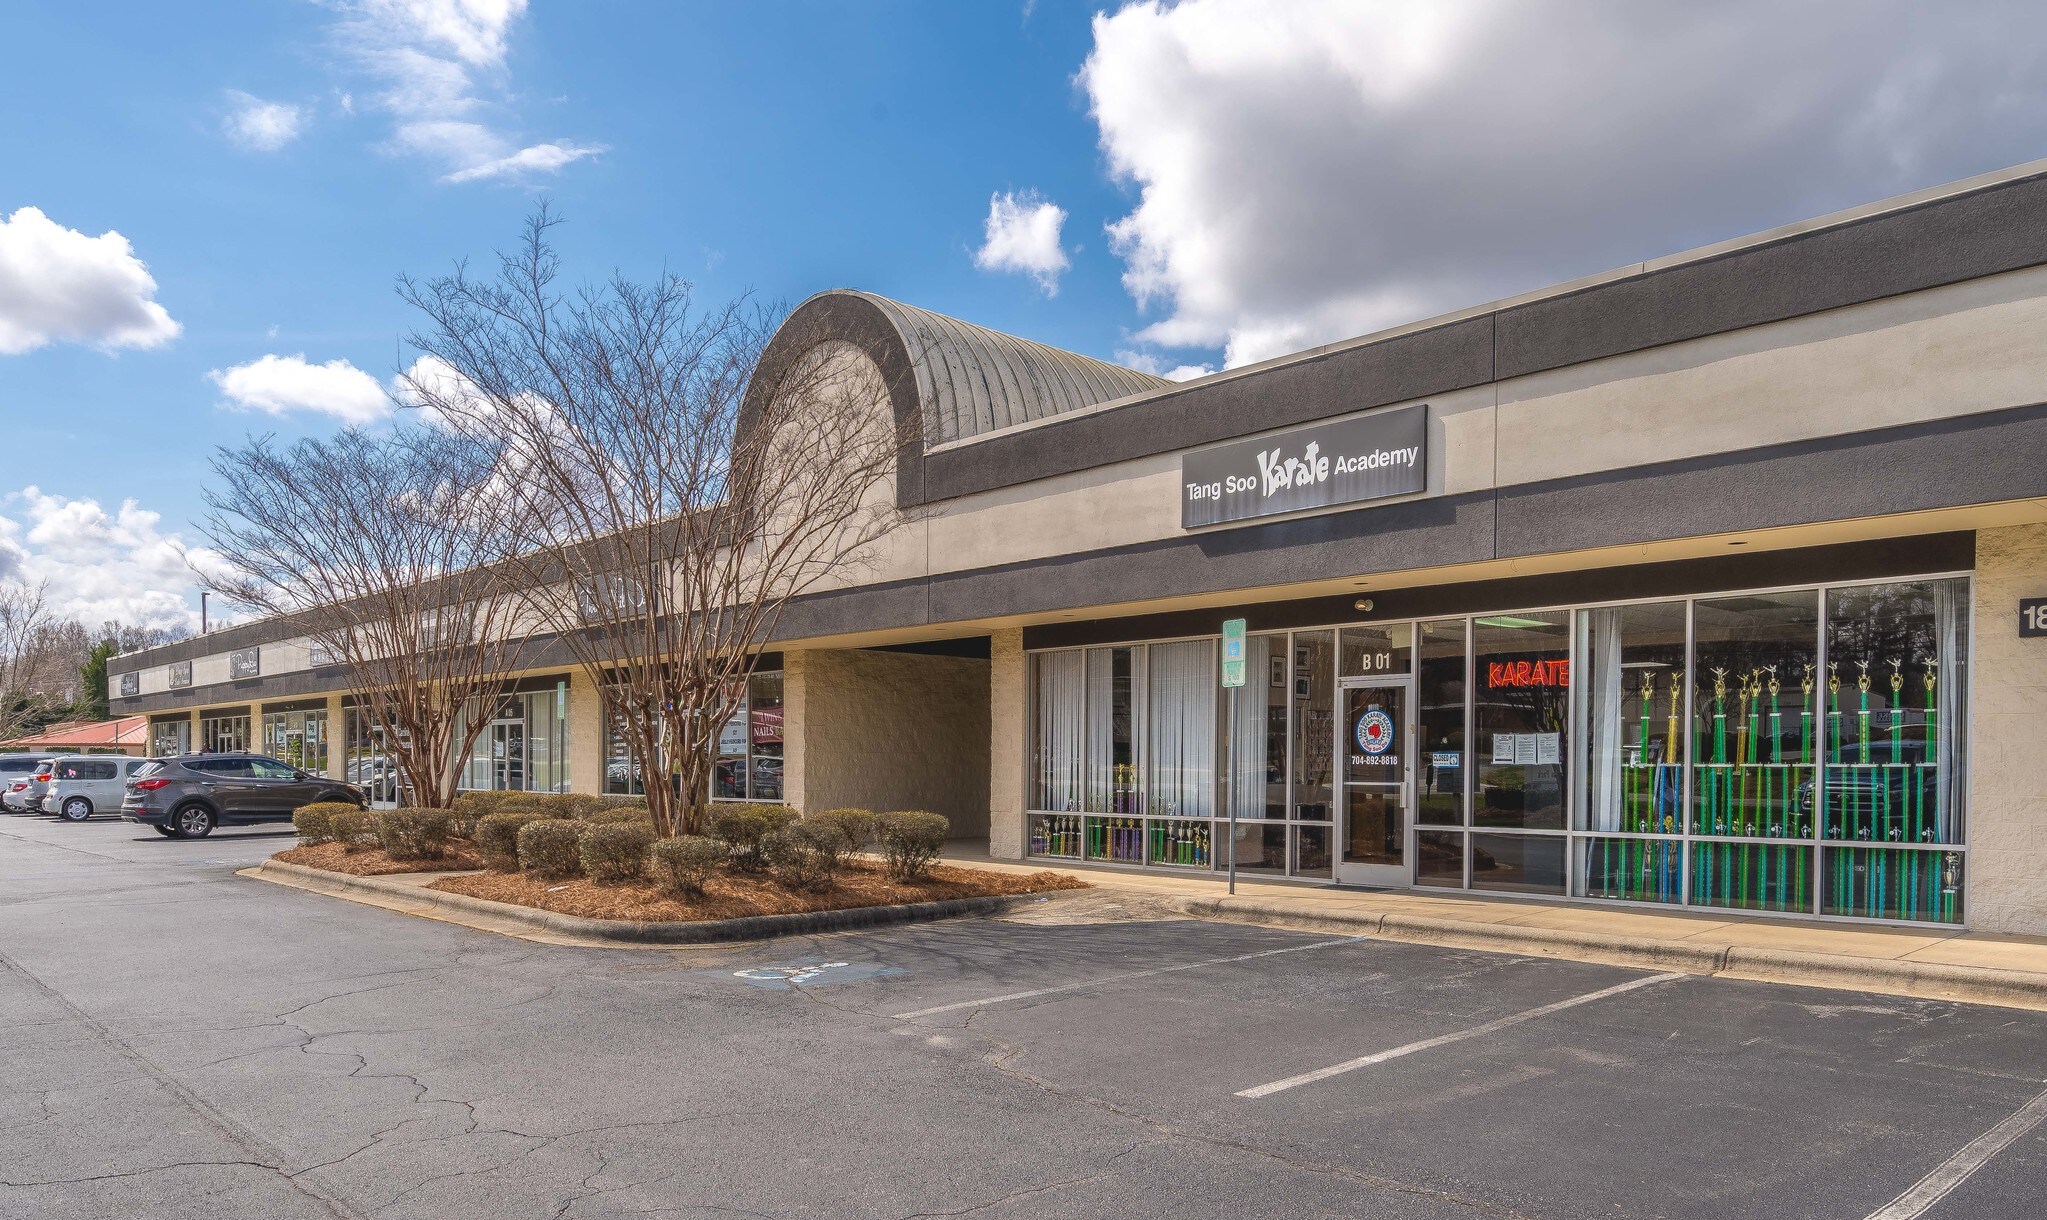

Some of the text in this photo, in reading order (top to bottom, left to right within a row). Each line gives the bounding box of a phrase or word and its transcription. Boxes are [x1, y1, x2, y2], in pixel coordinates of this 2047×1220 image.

[1186, 440, 1419, 501] Tang Soo Karate Academy
[1363, 653, 1390, 670] B 01
[1489, 659, 1569, 689] KARATE
[754, 726, 774, 737] NAILS
[1351, 755, 1398, 765] 704-892-8818
